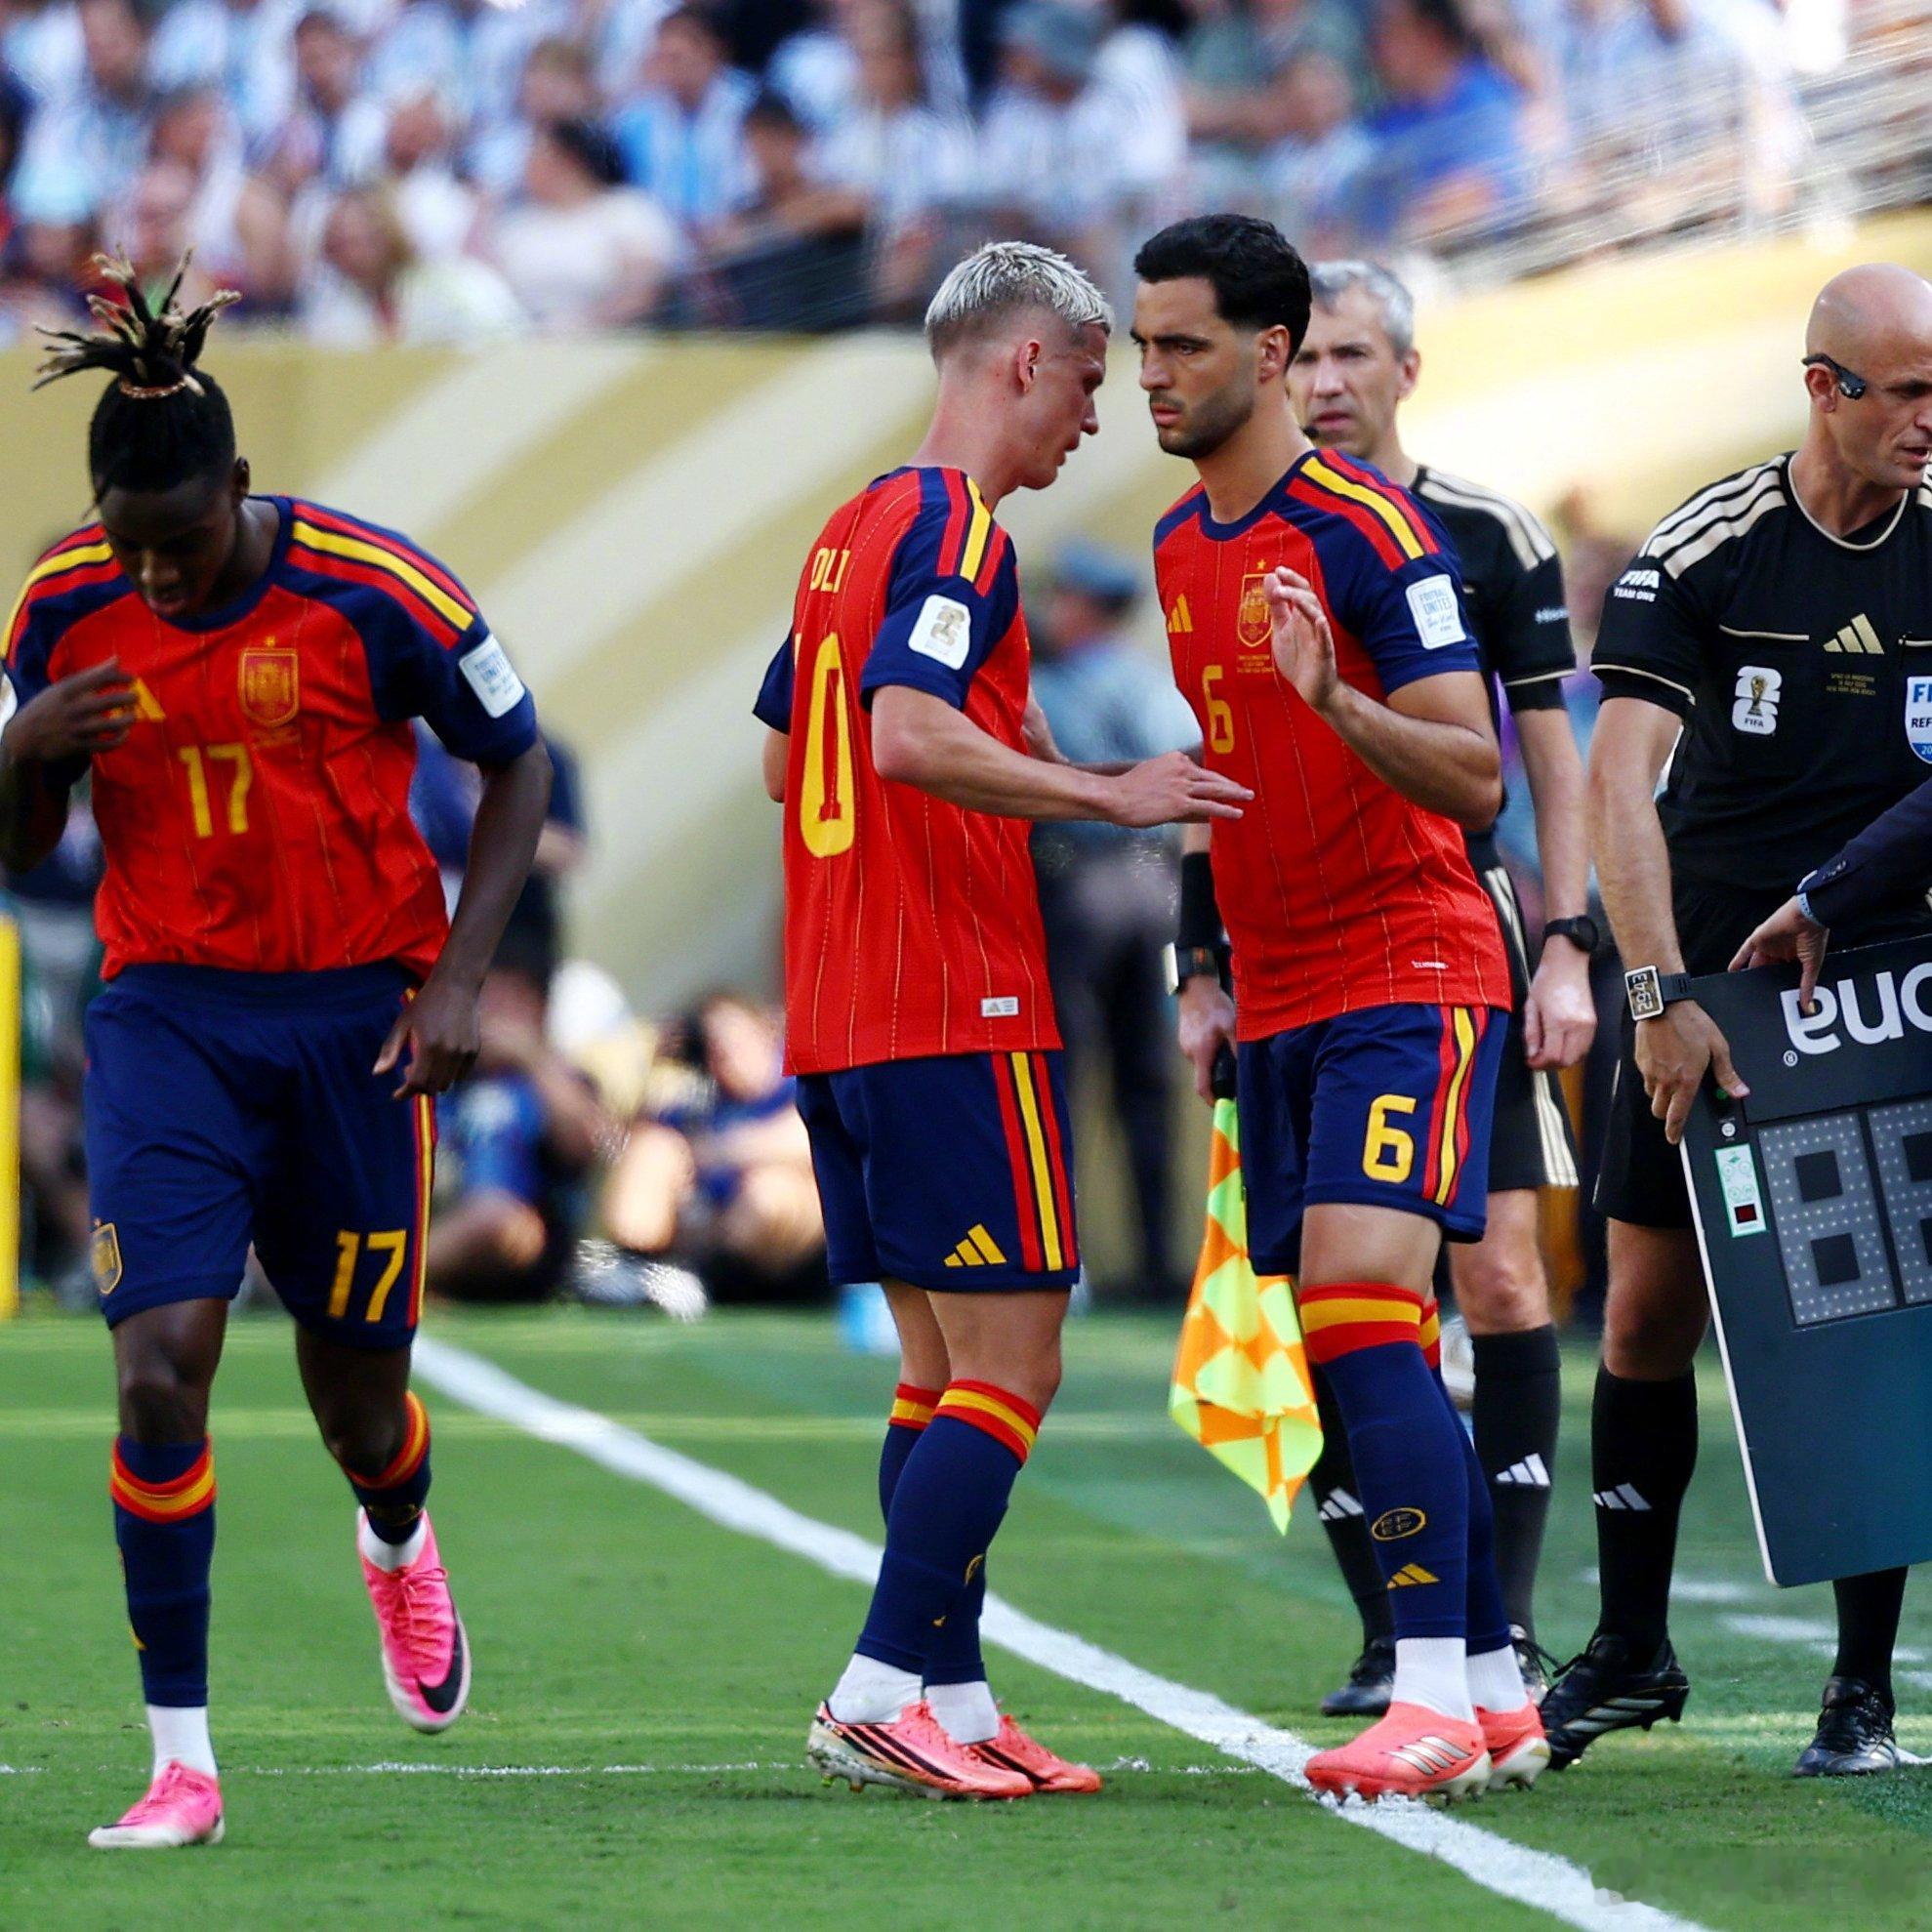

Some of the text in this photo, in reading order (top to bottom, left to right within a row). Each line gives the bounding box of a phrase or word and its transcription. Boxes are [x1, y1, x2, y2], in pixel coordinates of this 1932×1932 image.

[1619, 568, 1660, 589] FIFA
[1202, 665, 1235, 755] 6
[1744, 718, 1765, 728] FIFA
[1911, 718, 1932, 728] REF
[179, 743, 253, 839] 17
[1362, 1093, 1418, 1183] 6
[328, 1229, 407, 1324] 17
